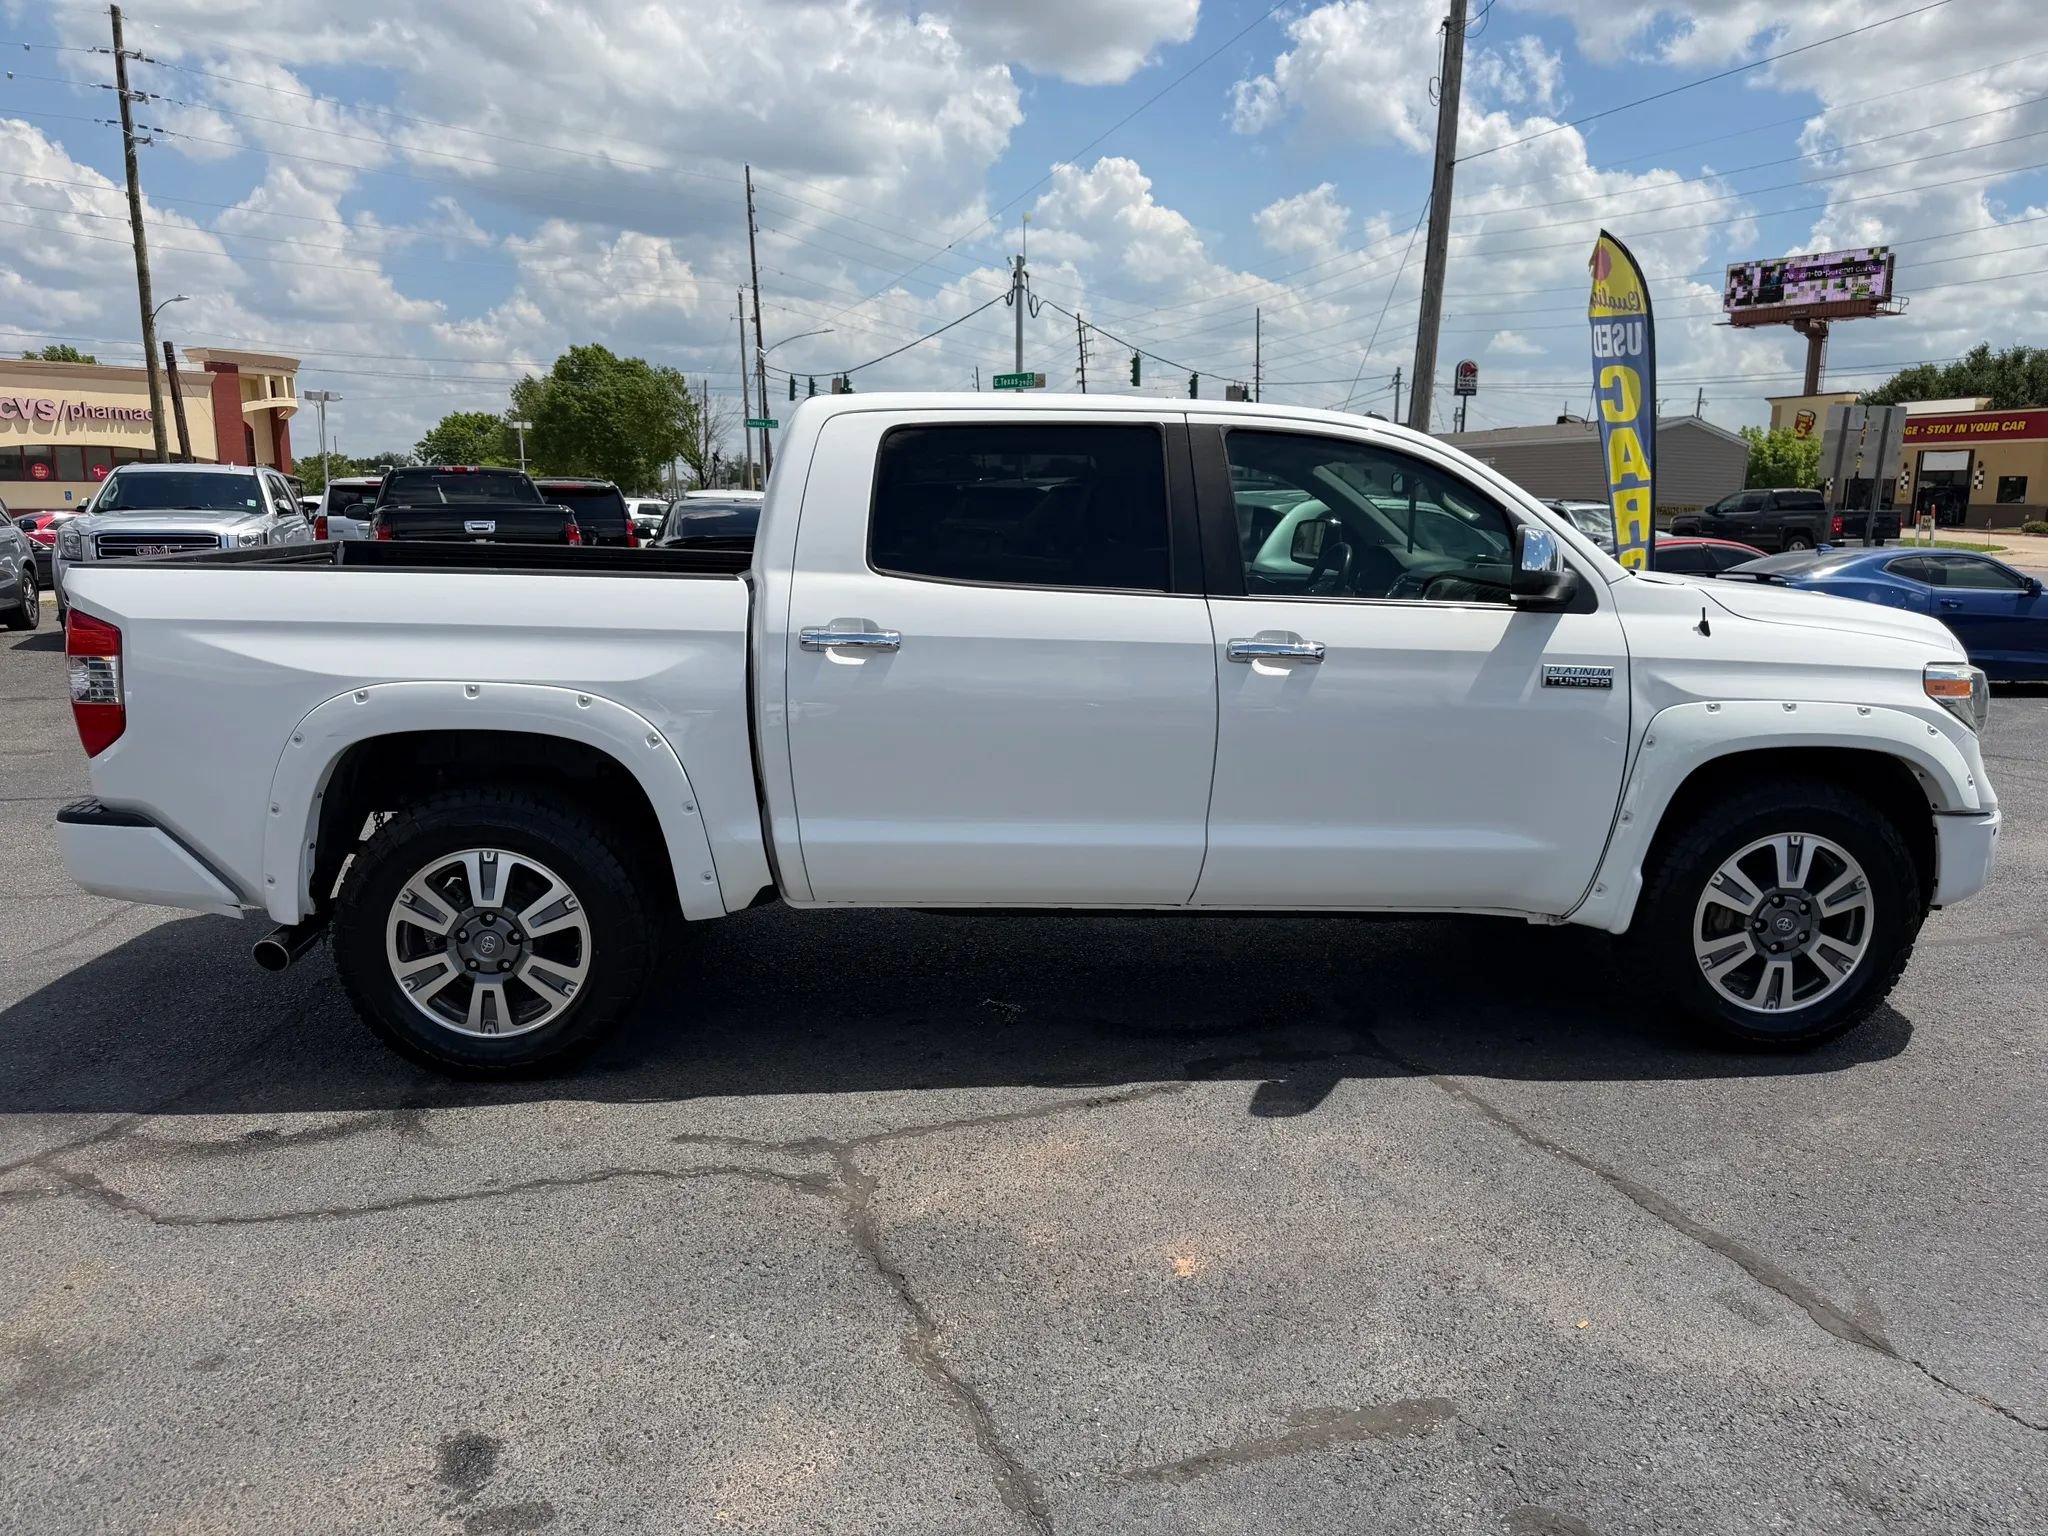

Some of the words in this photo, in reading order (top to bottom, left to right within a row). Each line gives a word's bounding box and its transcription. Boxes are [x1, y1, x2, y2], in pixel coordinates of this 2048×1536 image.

[1000, 377, 1018, 387] Texas
[0, 397, 152, 421] CVS/pharmac
[1797, 422, 1807, 438] 5
[1926, 424, 1954, 435] STAY
[1954, 423, 1967, 433] IN
[1970, 421, 1999, 432] YOUR
[2001, 421, 2026, 431] CAR
[1548, 666, 1611, 677] PLATINUM
[1548, 676, 1611, 687] TUNDRA
